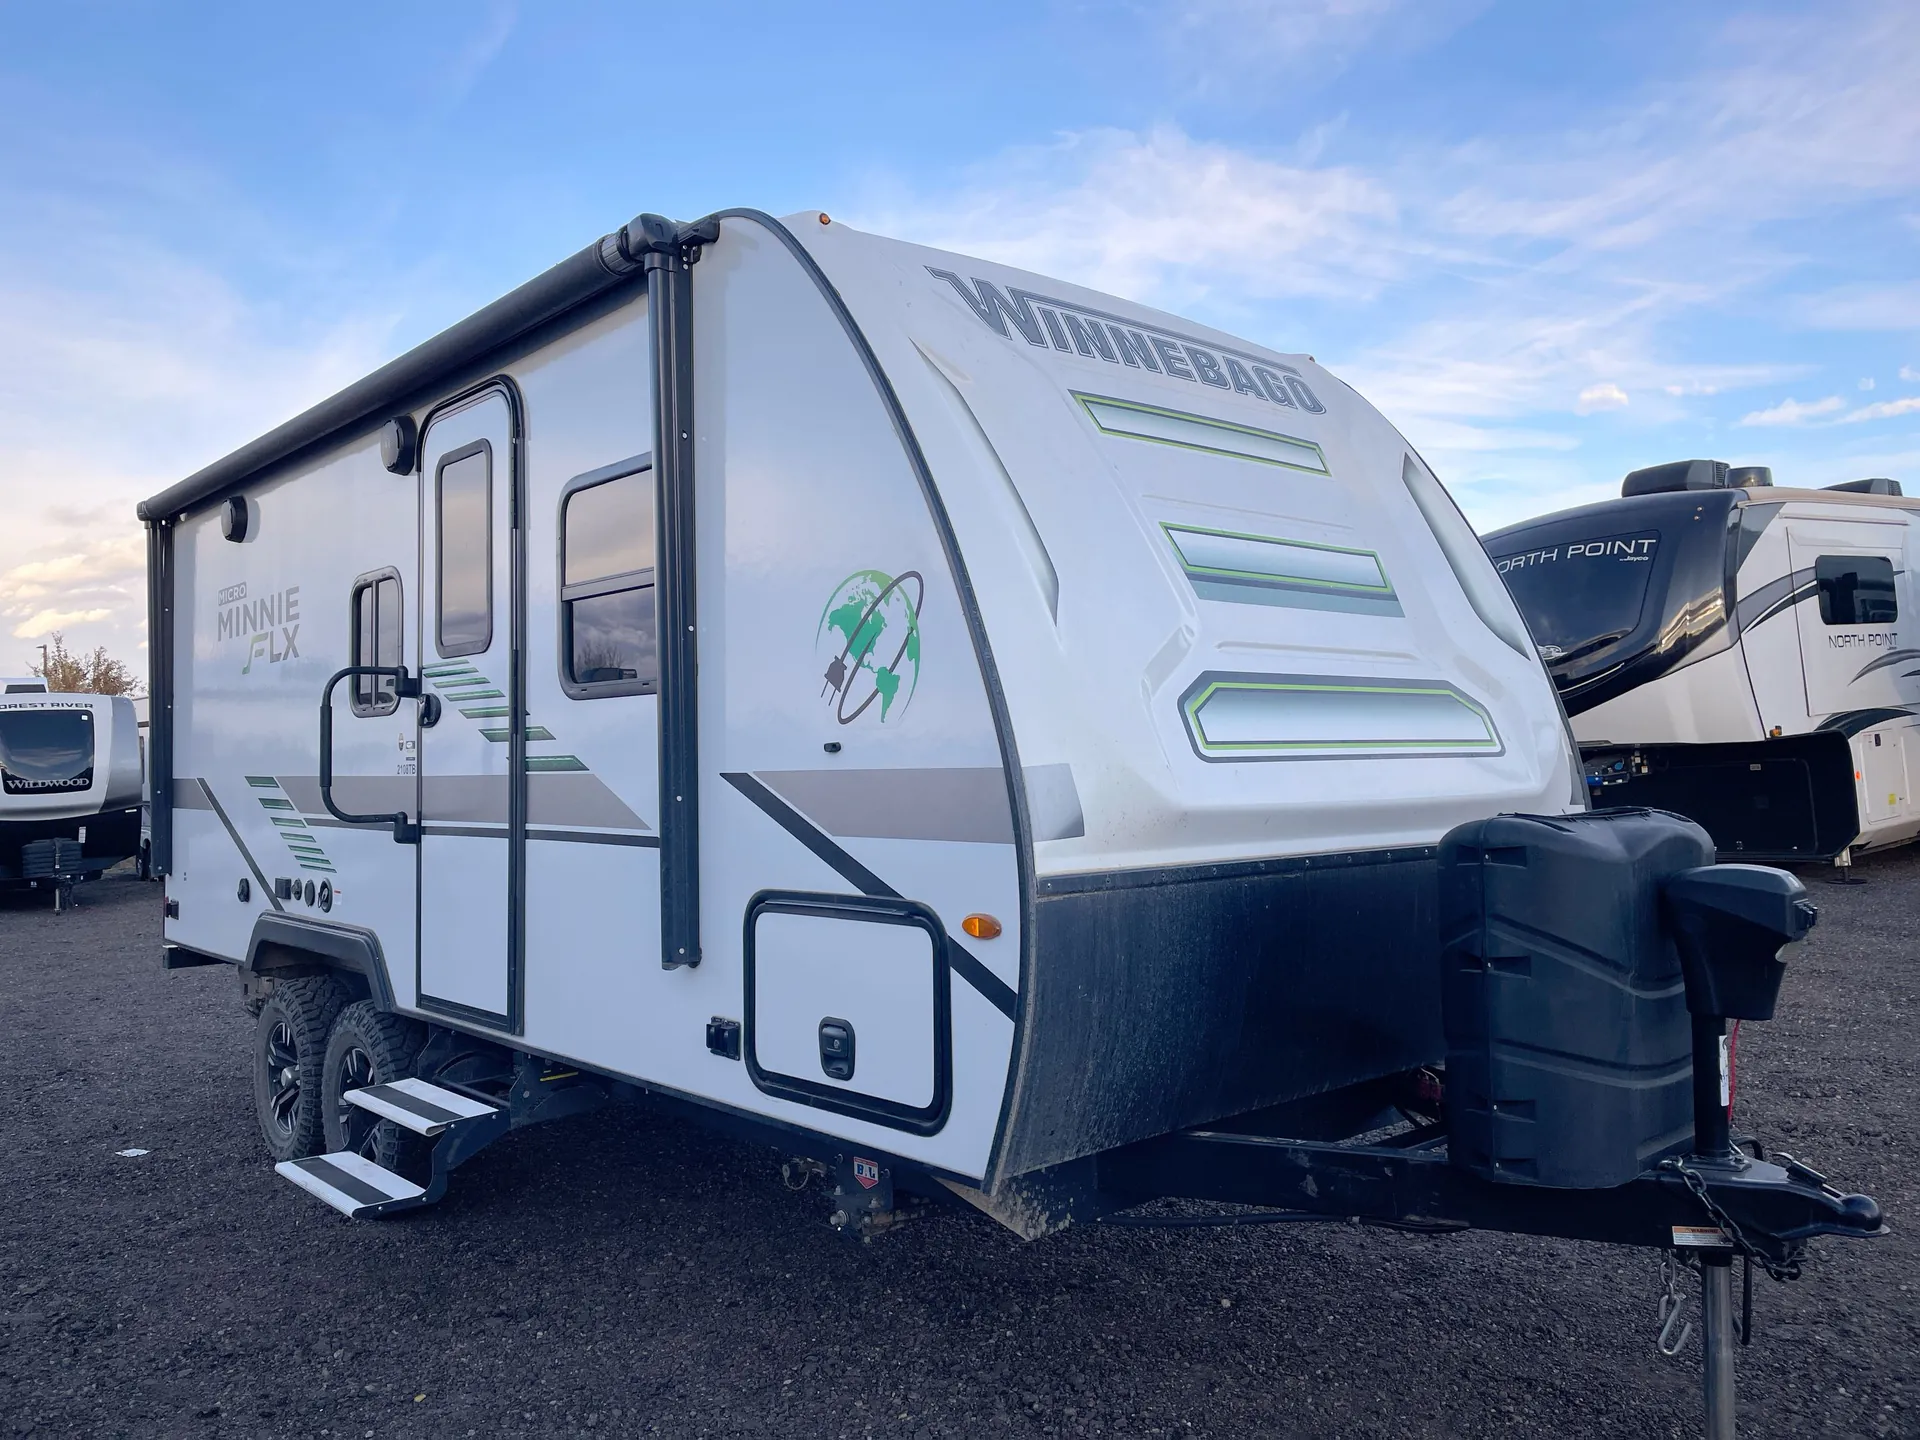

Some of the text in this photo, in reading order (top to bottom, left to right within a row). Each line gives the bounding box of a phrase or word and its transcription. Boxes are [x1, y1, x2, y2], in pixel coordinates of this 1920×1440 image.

[924, 265, 1326, 414] WINNEBAGO
[1496, 539, 1656, 574] ORTH POINT
[218, 583, 246, 605] MICRO
[218, 586, 300, 642] MINNIE
[242, 623, 300, 675] FLX
[1828, 633, 1898, 649] NORTH POINT
[6, 778, 89, 789] WILDWOOD
